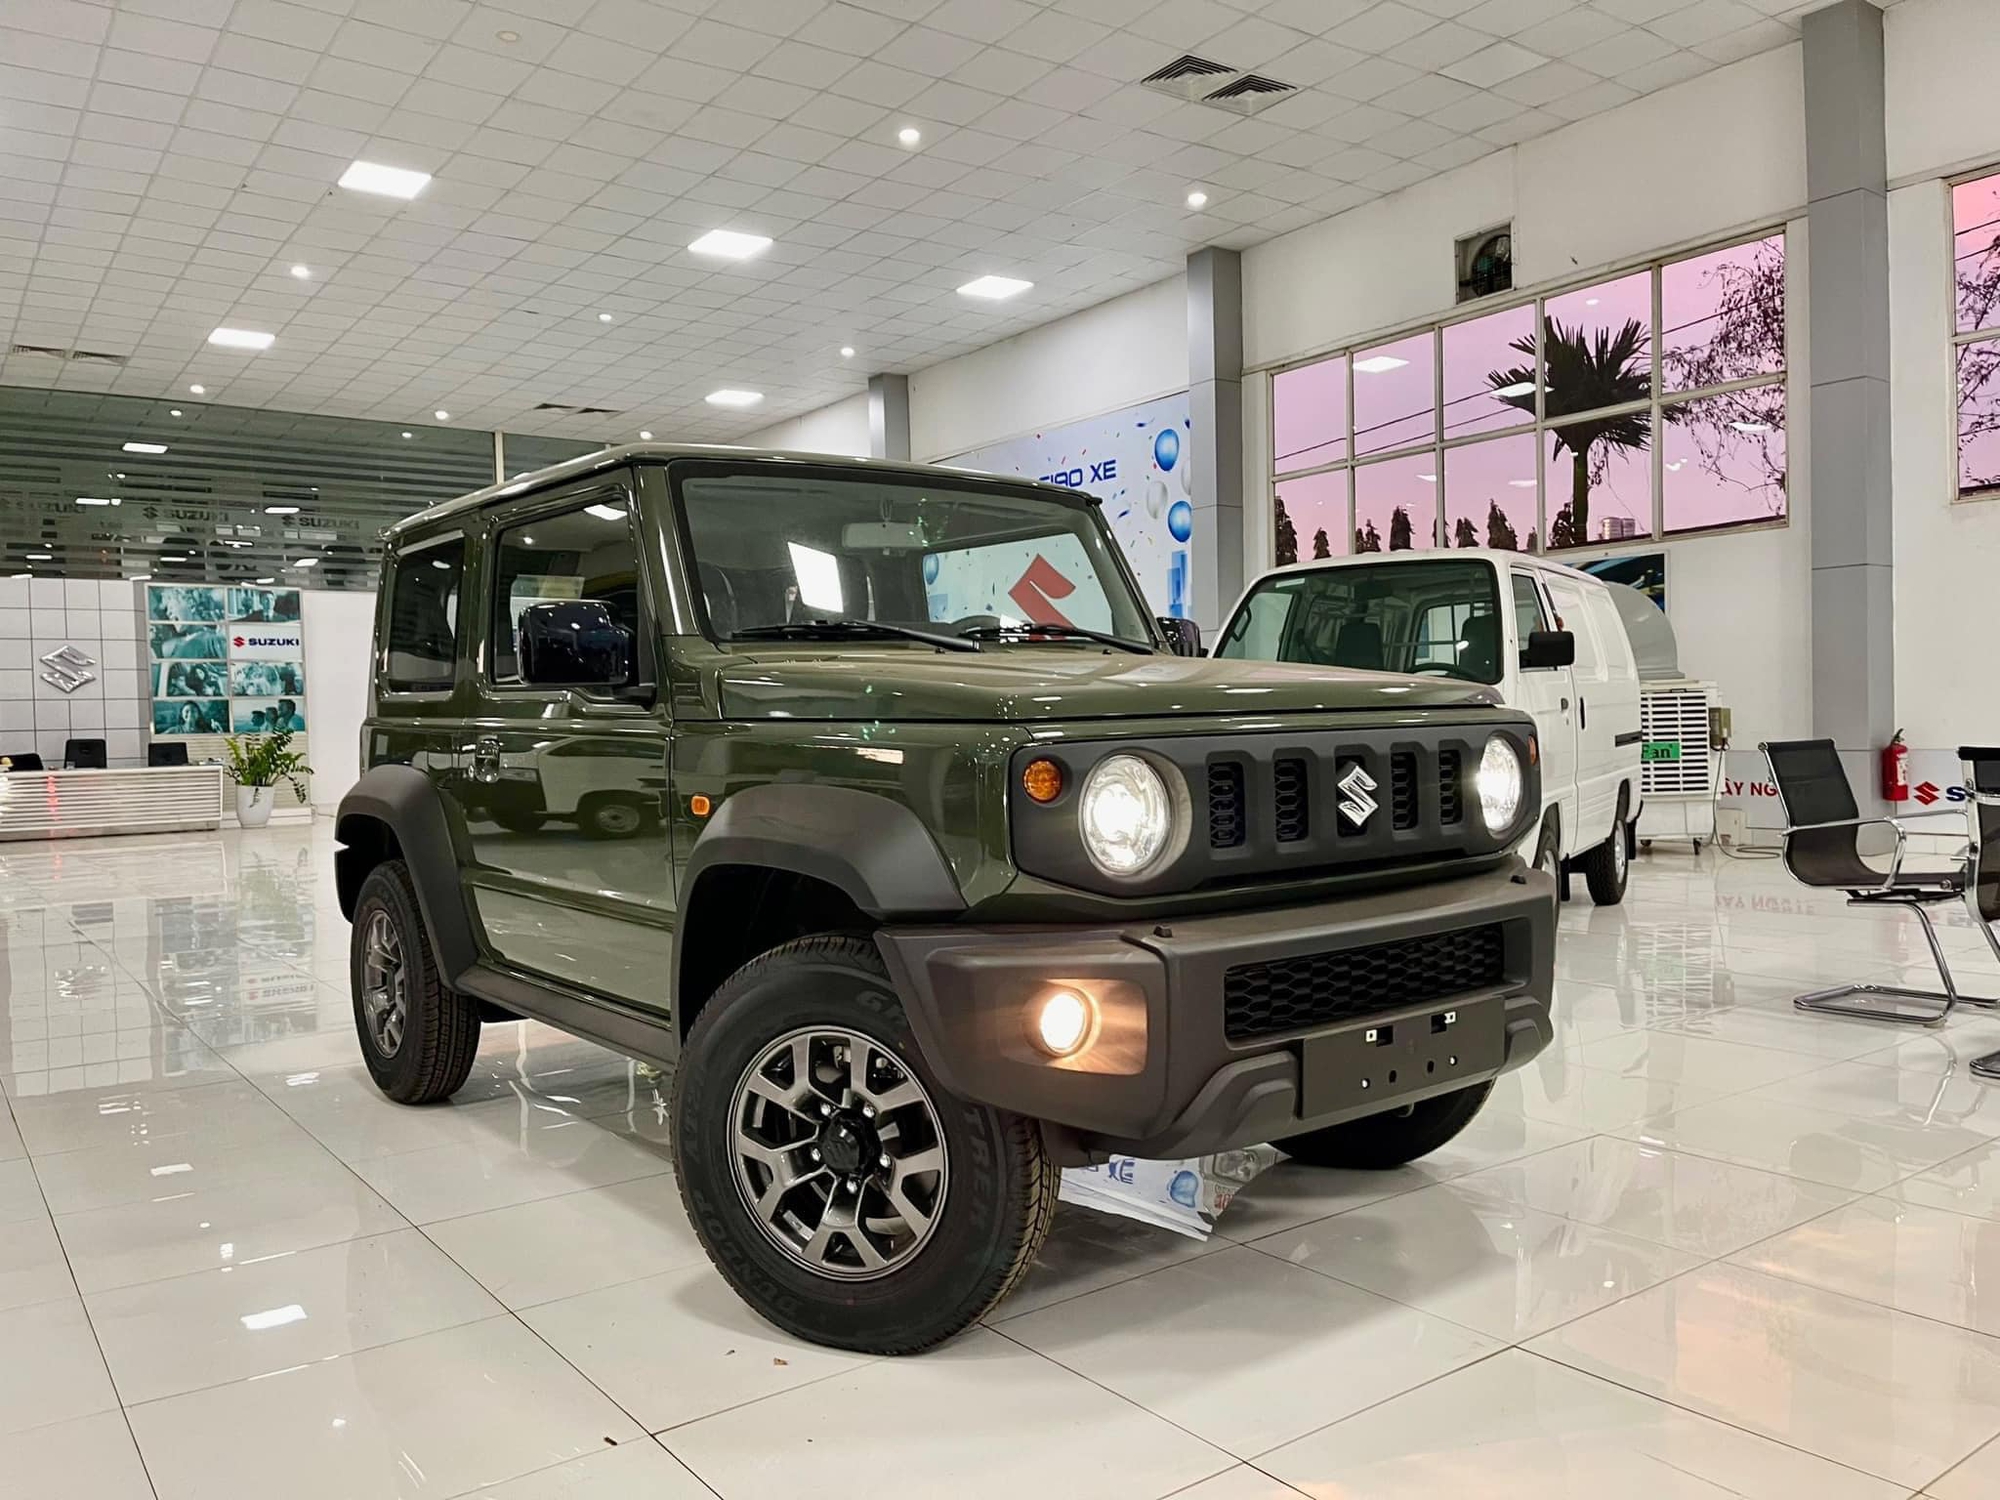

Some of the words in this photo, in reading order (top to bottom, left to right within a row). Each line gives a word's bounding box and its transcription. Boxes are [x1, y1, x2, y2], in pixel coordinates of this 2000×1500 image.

[1089, 459, 1117, 484] XE
[162, 509, 229, 521] SUZUKI
[299, 517, 361, 530] SUZUKI
[248, 638, 300, 647] SUZUKI
[692, 1188, 799, 1313] DUNLOP
